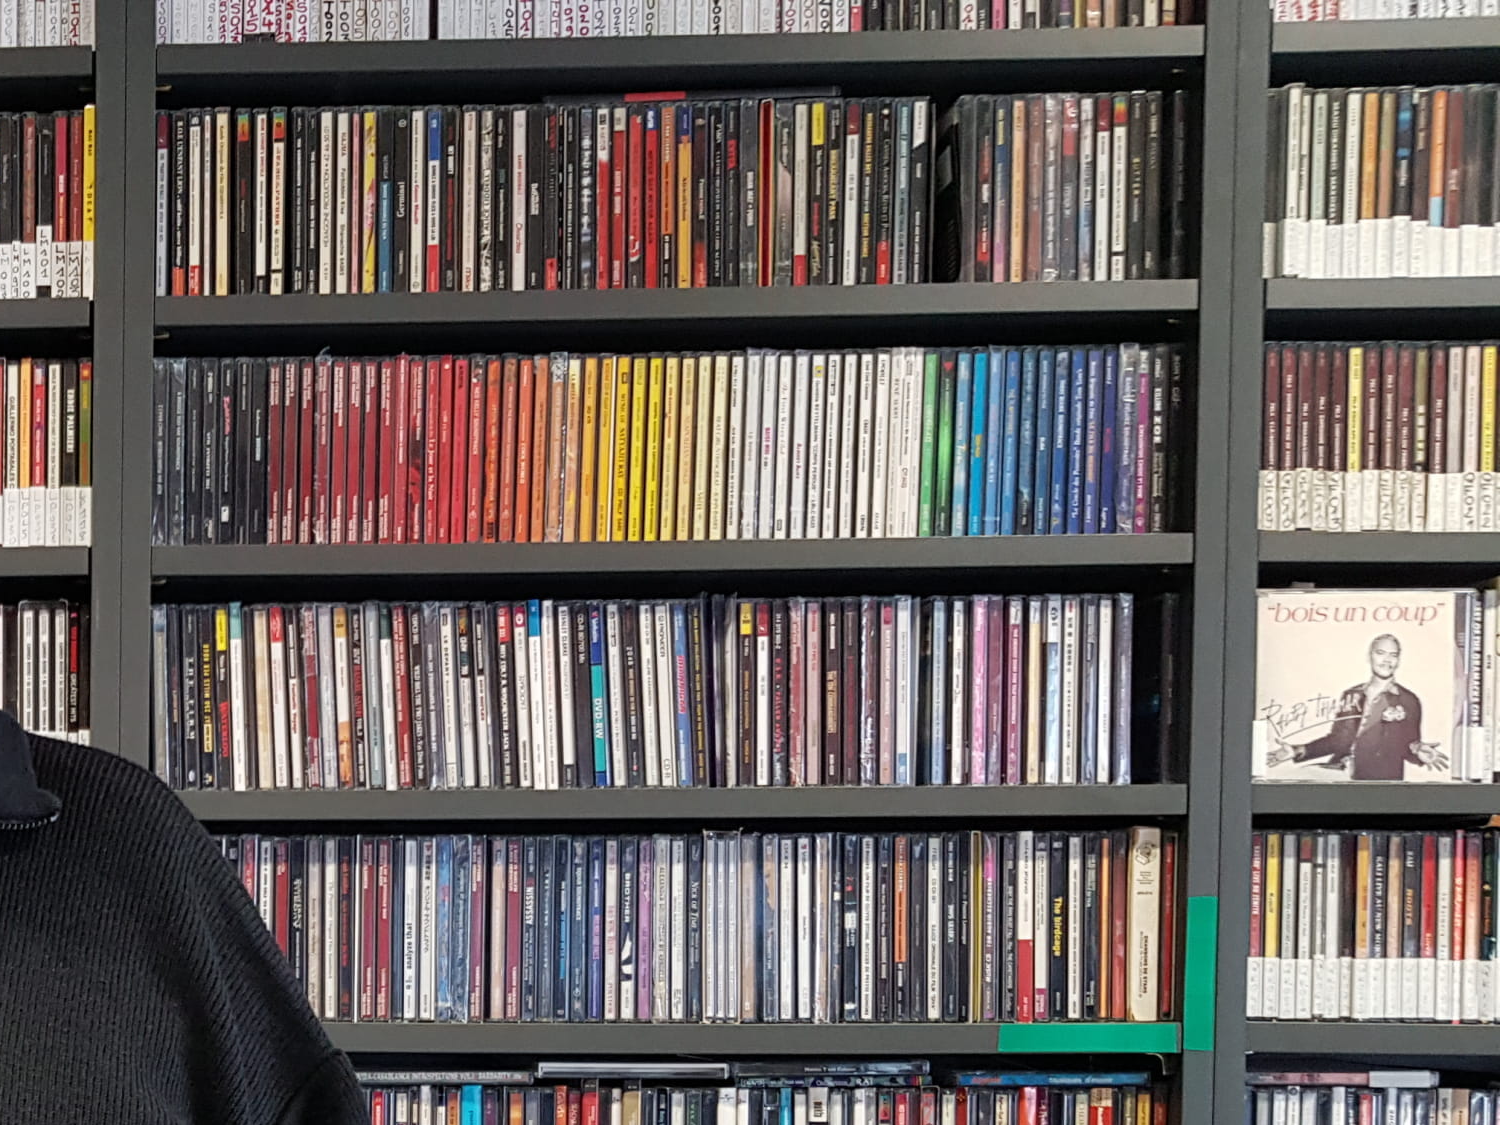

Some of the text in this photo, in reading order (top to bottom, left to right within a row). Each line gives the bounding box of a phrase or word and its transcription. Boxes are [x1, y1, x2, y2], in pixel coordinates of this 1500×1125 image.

[396, 182, 406, 217] Germinal
[428, 483, 436, 501] Nuit
[1335, 605, 1365, 622] un
[594, 698, 603, 738] DVD-RW
[623, 873, 631, 923] BROTHER
[406, 922, 415, 970] analyze that
[1053, 896, 1063, 956] The birdcage
